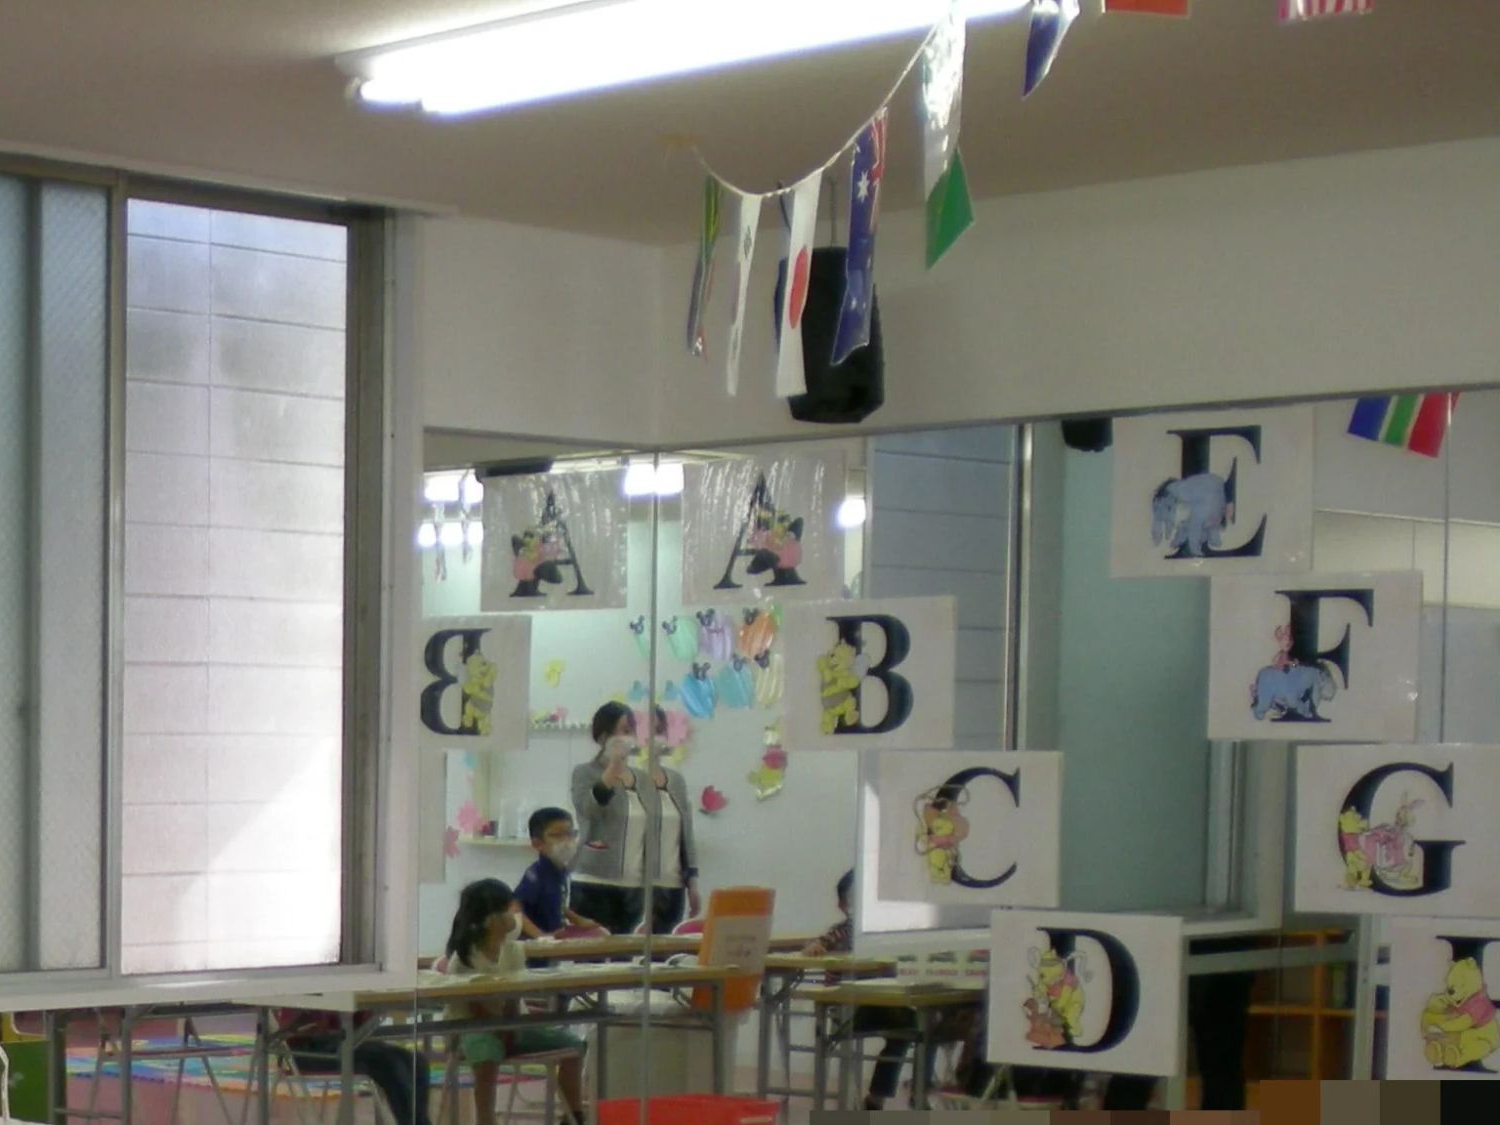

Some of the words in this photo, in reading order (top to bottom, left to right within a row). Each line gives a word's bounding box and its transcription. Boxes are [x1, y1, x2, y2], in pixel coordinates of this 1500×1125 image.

[713, 472, 808, 590] A
[1164, 425, 1267, 559] E
[823, 613, 914, 735] B
[1271, 588, 1374, 722] F
[930, 767, 1021, 889] C
[1339, 762, 1466, 897] G
[1033, 926, 1140, 1053] D
